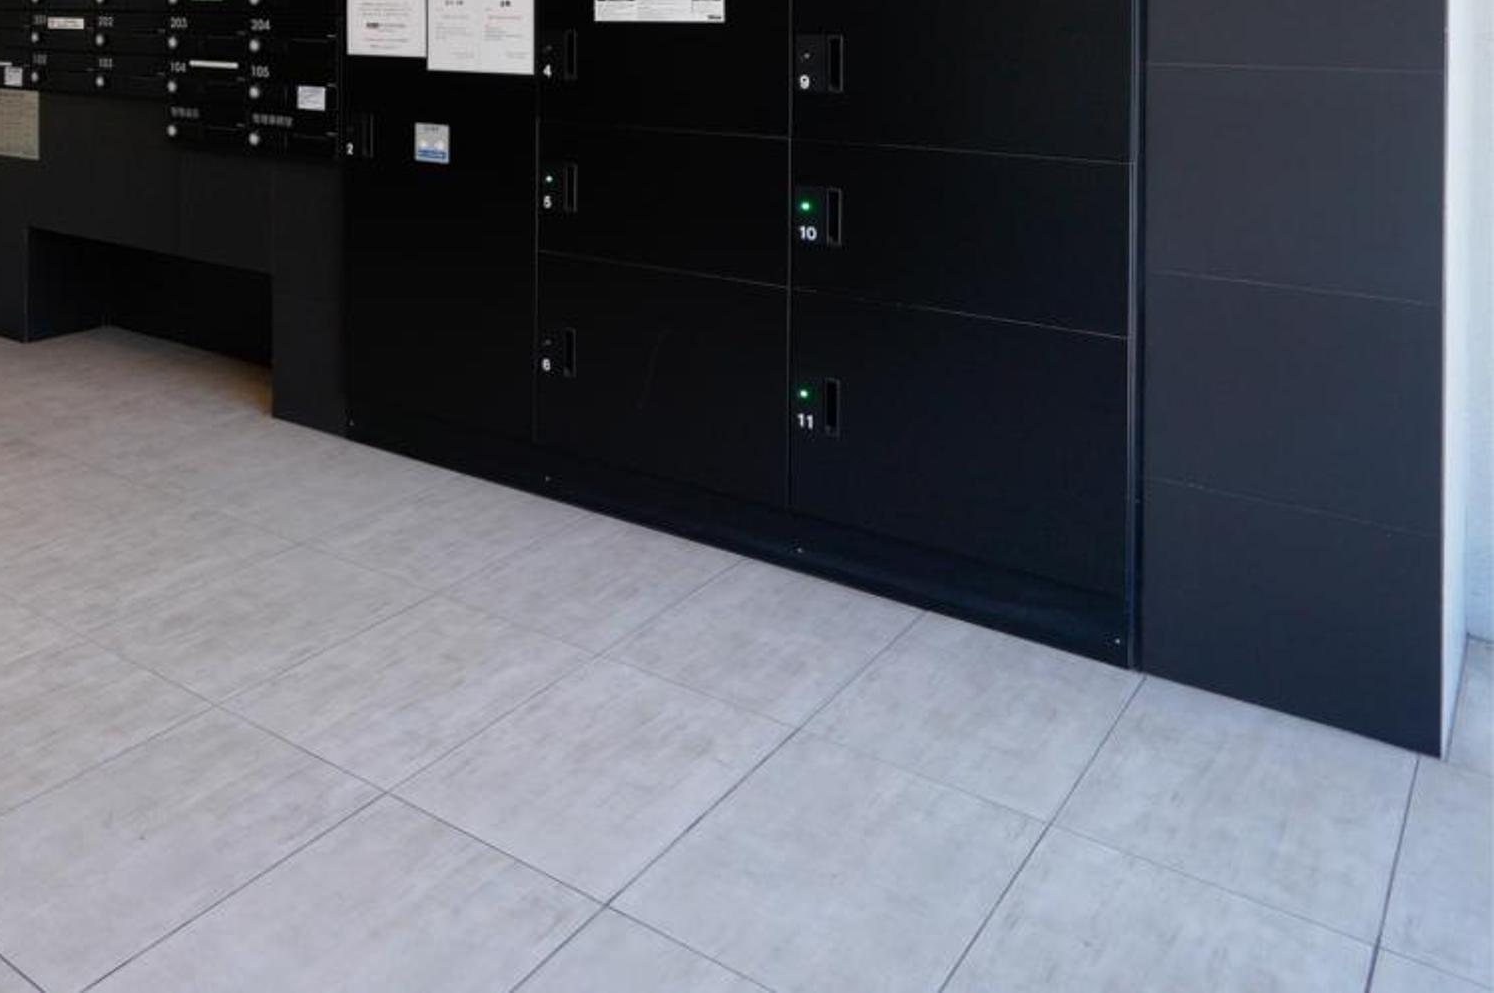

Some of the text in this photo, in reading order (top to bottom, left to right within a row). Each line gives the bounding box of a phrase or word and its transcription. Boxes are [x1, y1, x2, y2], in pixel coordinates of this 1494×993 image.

[171, 17, 187, 28] 203
[251, 19, 270, 30] 204
[252, 65, 269, 77] 105
[542, 64, 552, 77] 4
[799, 74, 810, 90] 9
[346, 142, 354, 155] 2
[543, 195, 552, 209] 5
[799, 225, 818, 241] 10
[541, 358, 551, 372] 6
[797, 412, 814, 430] 11
